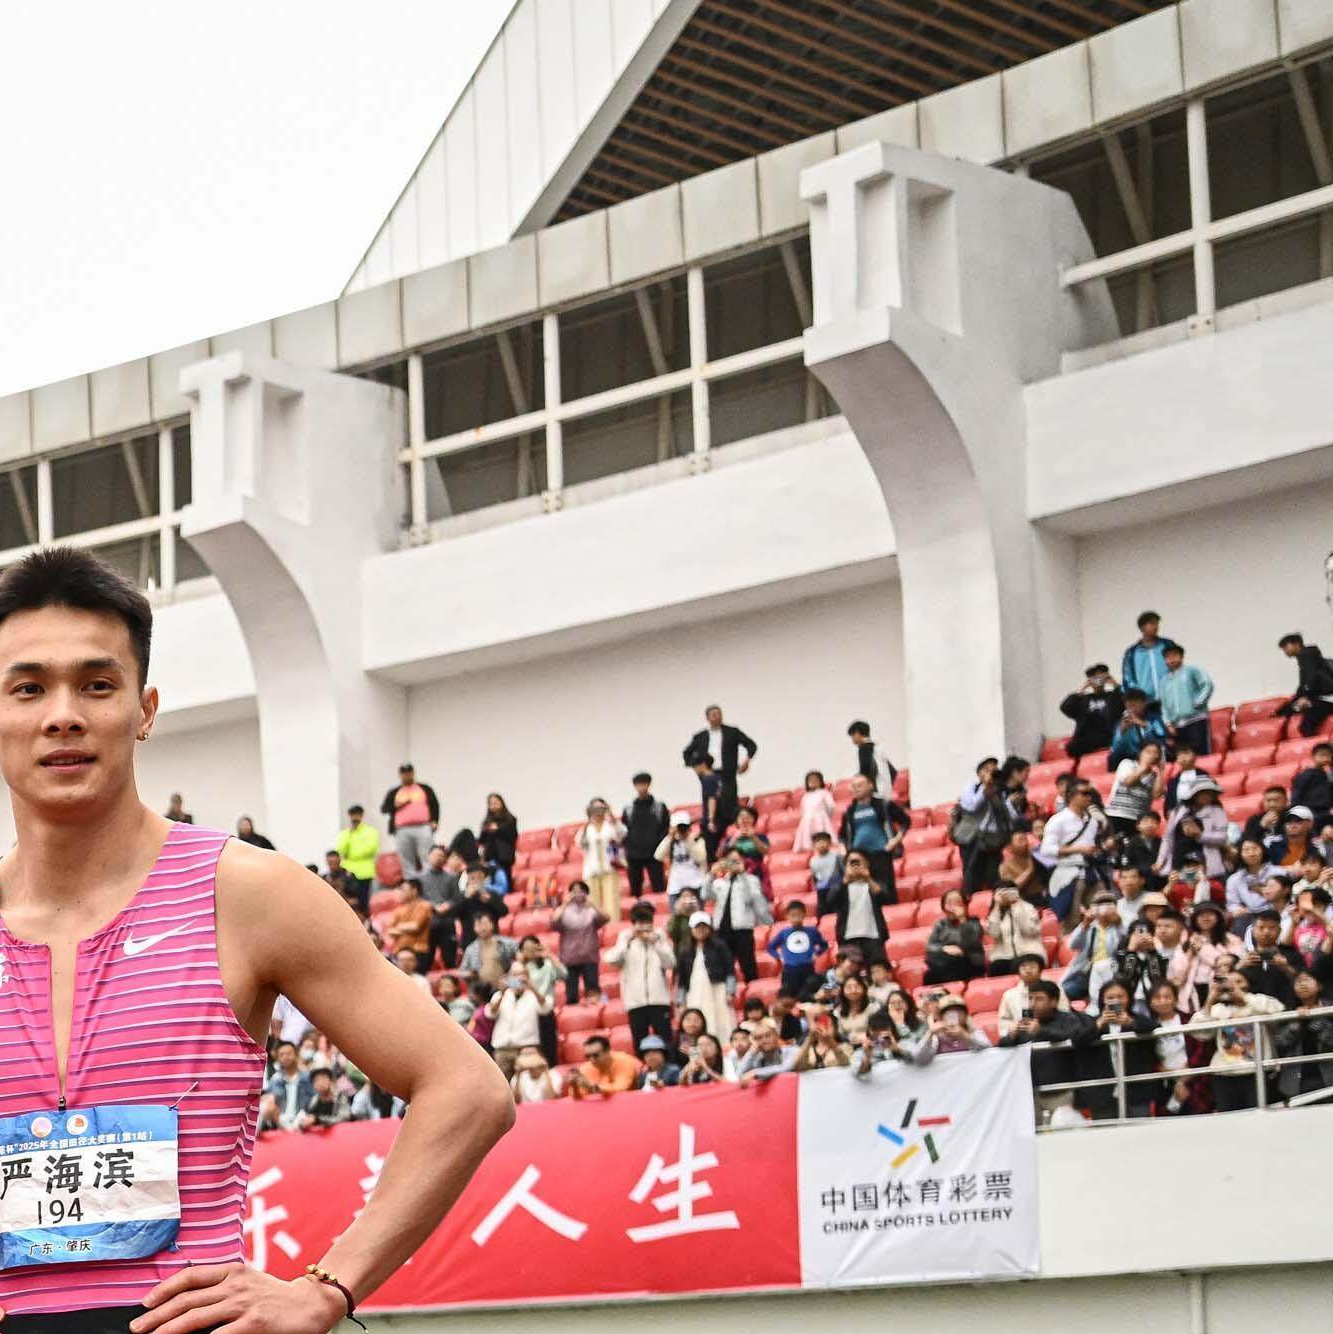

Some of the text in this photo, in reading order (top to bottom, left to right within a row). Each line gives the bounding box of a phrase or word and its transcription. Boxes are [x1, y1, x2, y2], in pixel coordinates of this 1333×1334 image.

[0, 1148, 135, 1201] 严海滨
[821, 1169, 1014, 1214] 中国体育彩票
[37, 1197, 84, 1225] 194
[823, 1206, 1014, 1235] CHINA SPORTS LOTTERY
